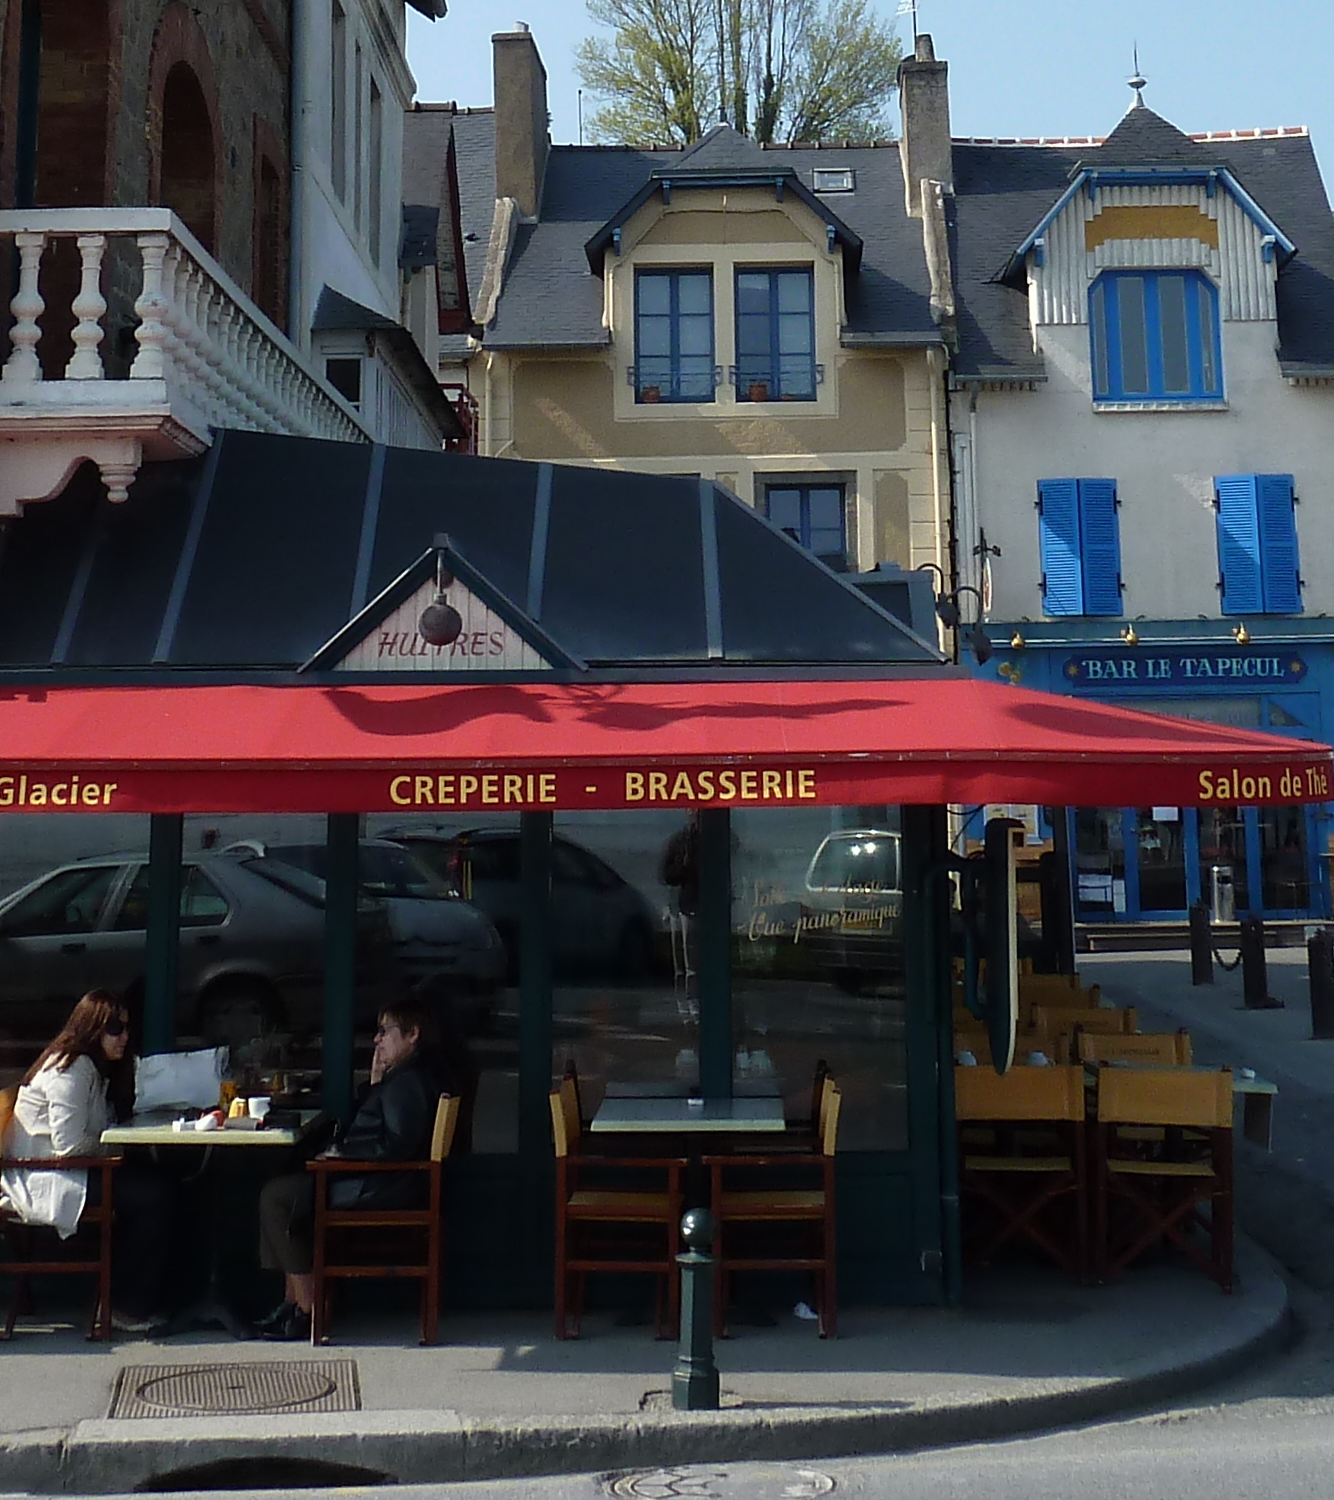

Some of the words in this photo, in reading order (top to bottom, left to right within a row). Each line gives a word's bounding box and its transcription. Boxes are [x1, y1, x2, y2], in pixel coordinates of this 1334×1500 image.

[378, 631, 505, 658] HUIRES
[1081, 658, 1139, 679] BAR
[1145, 659, 1172, 679] LE
[1178, 657, 1285, 678] TAPECUL
[389, 774, 557, 805] CREPERIE
[625, 770, 817, 801] BRASSERIE
[1199, 768, 1272, 800] Salon
[1279, 767, 1302, 797] de
[1305, 766, 1328, 796] Thé
[792, 902, 900, 945] panoramique
